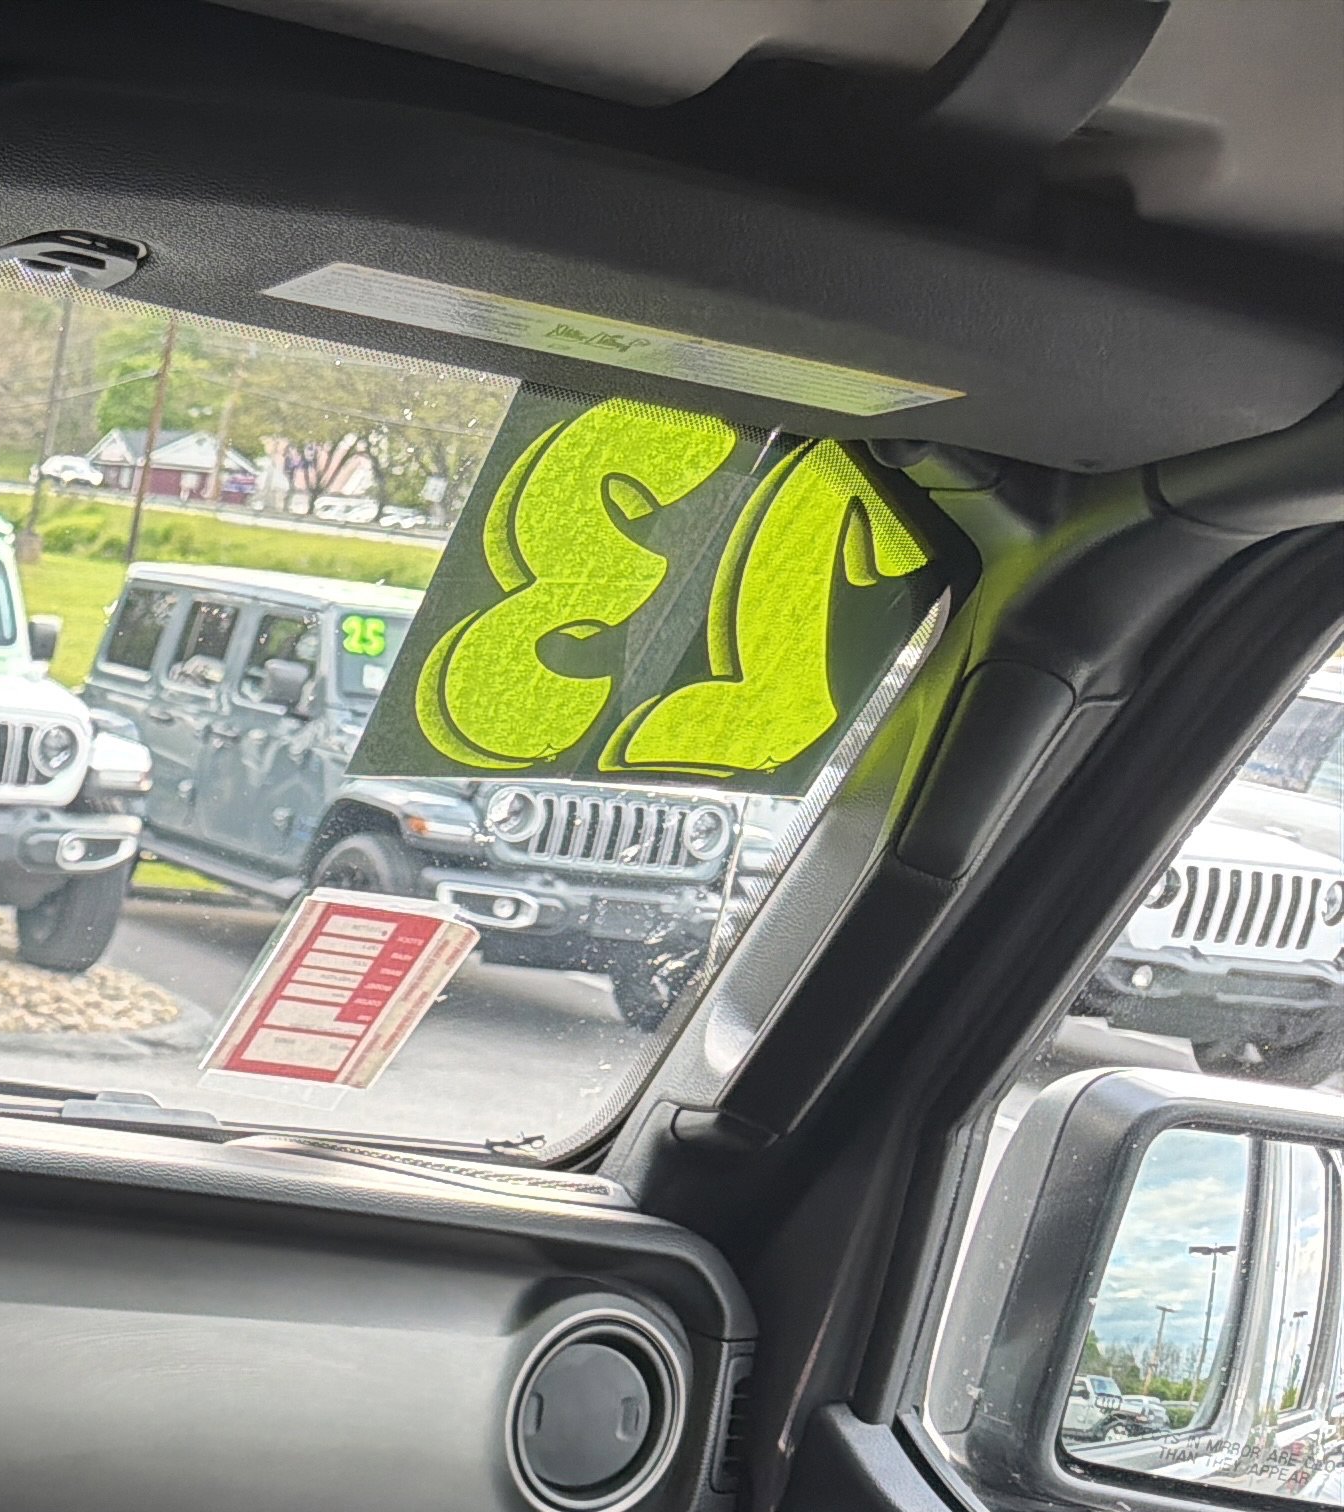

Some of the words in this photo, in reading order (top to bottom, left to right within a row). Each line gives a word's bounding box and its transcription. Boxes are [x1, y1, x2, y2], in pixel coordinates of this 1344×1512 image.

[342, 615, 385, 656] 25
[1159, 1445, 1196, 1465] THAN
[1247, 1464, 1312, 1486] APPEAR
[1206, 1440, 1261, 1458] MIRROR
[1267, 1450, 1301, 1467] ARE
